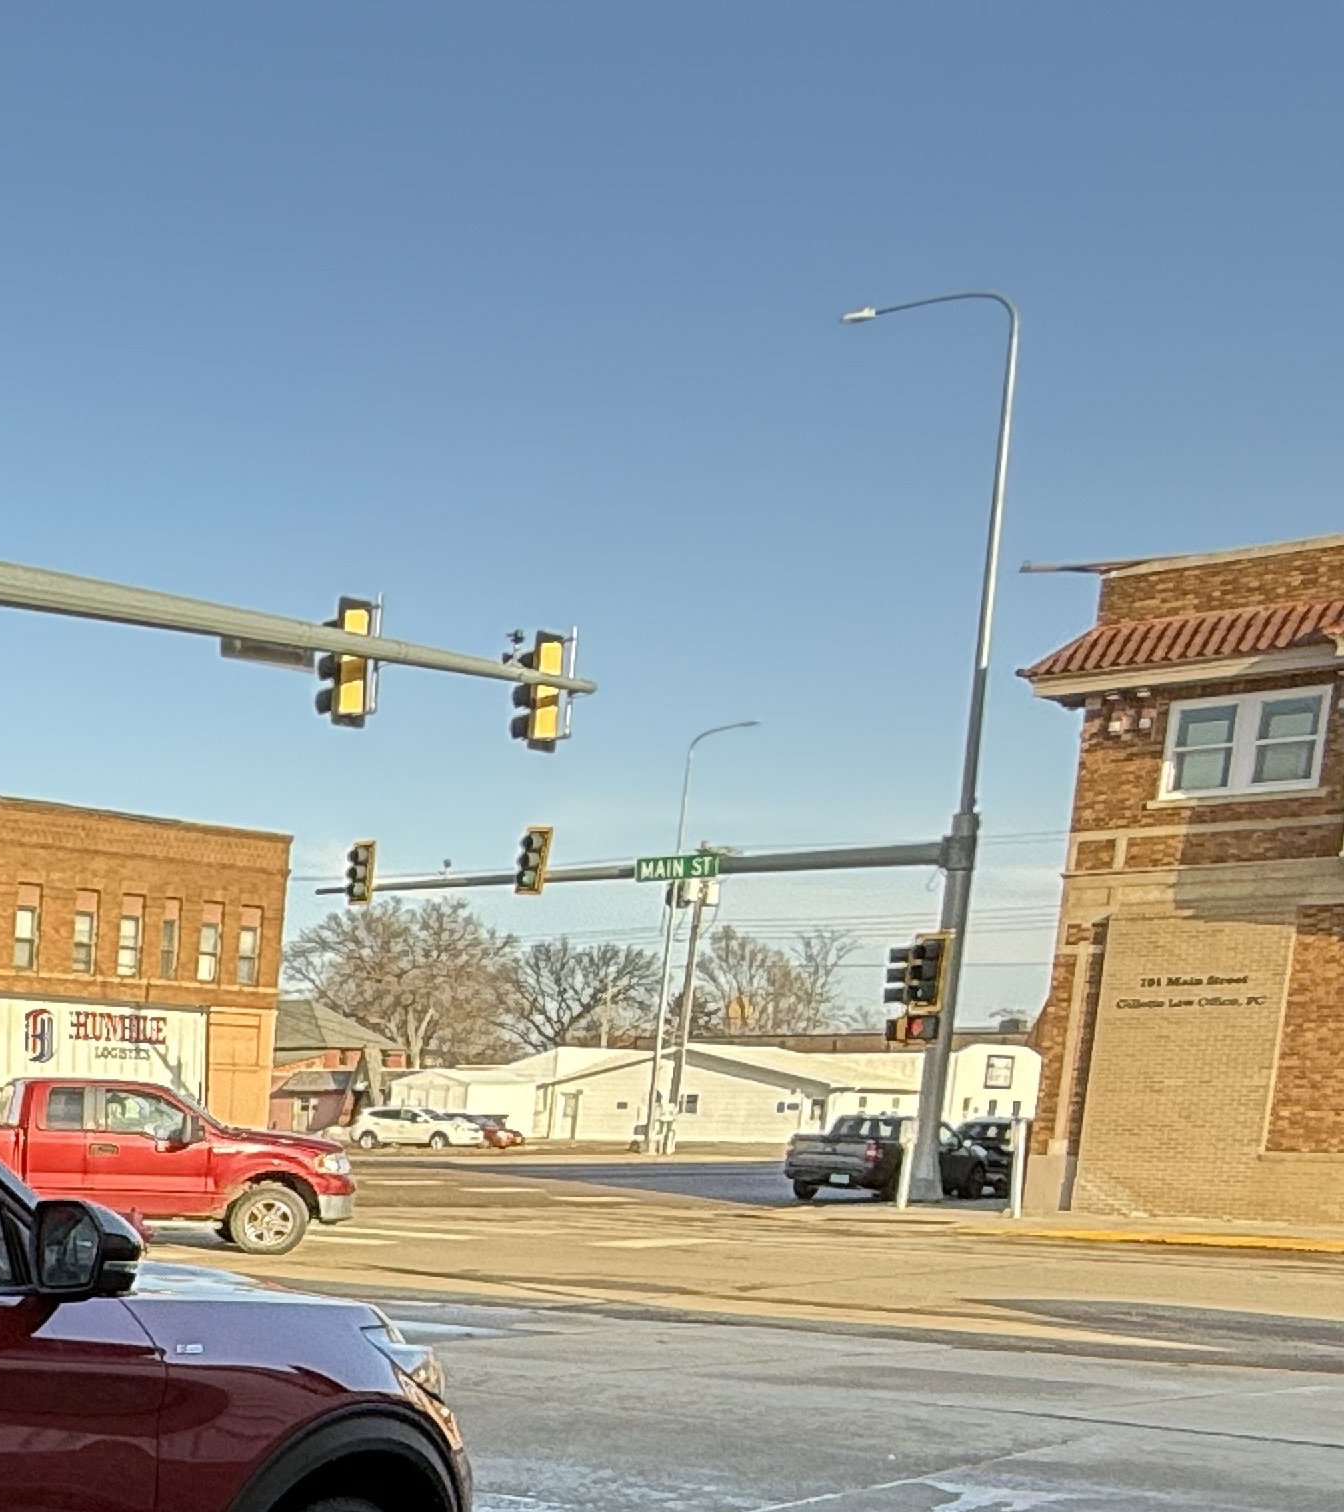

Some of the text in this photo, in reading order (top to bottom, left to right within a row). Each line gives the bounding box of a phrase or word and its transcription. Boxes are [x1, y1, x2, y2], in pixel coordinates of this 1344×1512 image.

[640, 856, 712, 880] MAIN ST
[1166, 976, 1204, 987] Main
[1206, 974, 1249, 986] Street
[1169, 998, 1194, 1008] Law
[94, 1045, 151, 1061] LOGISTICS
